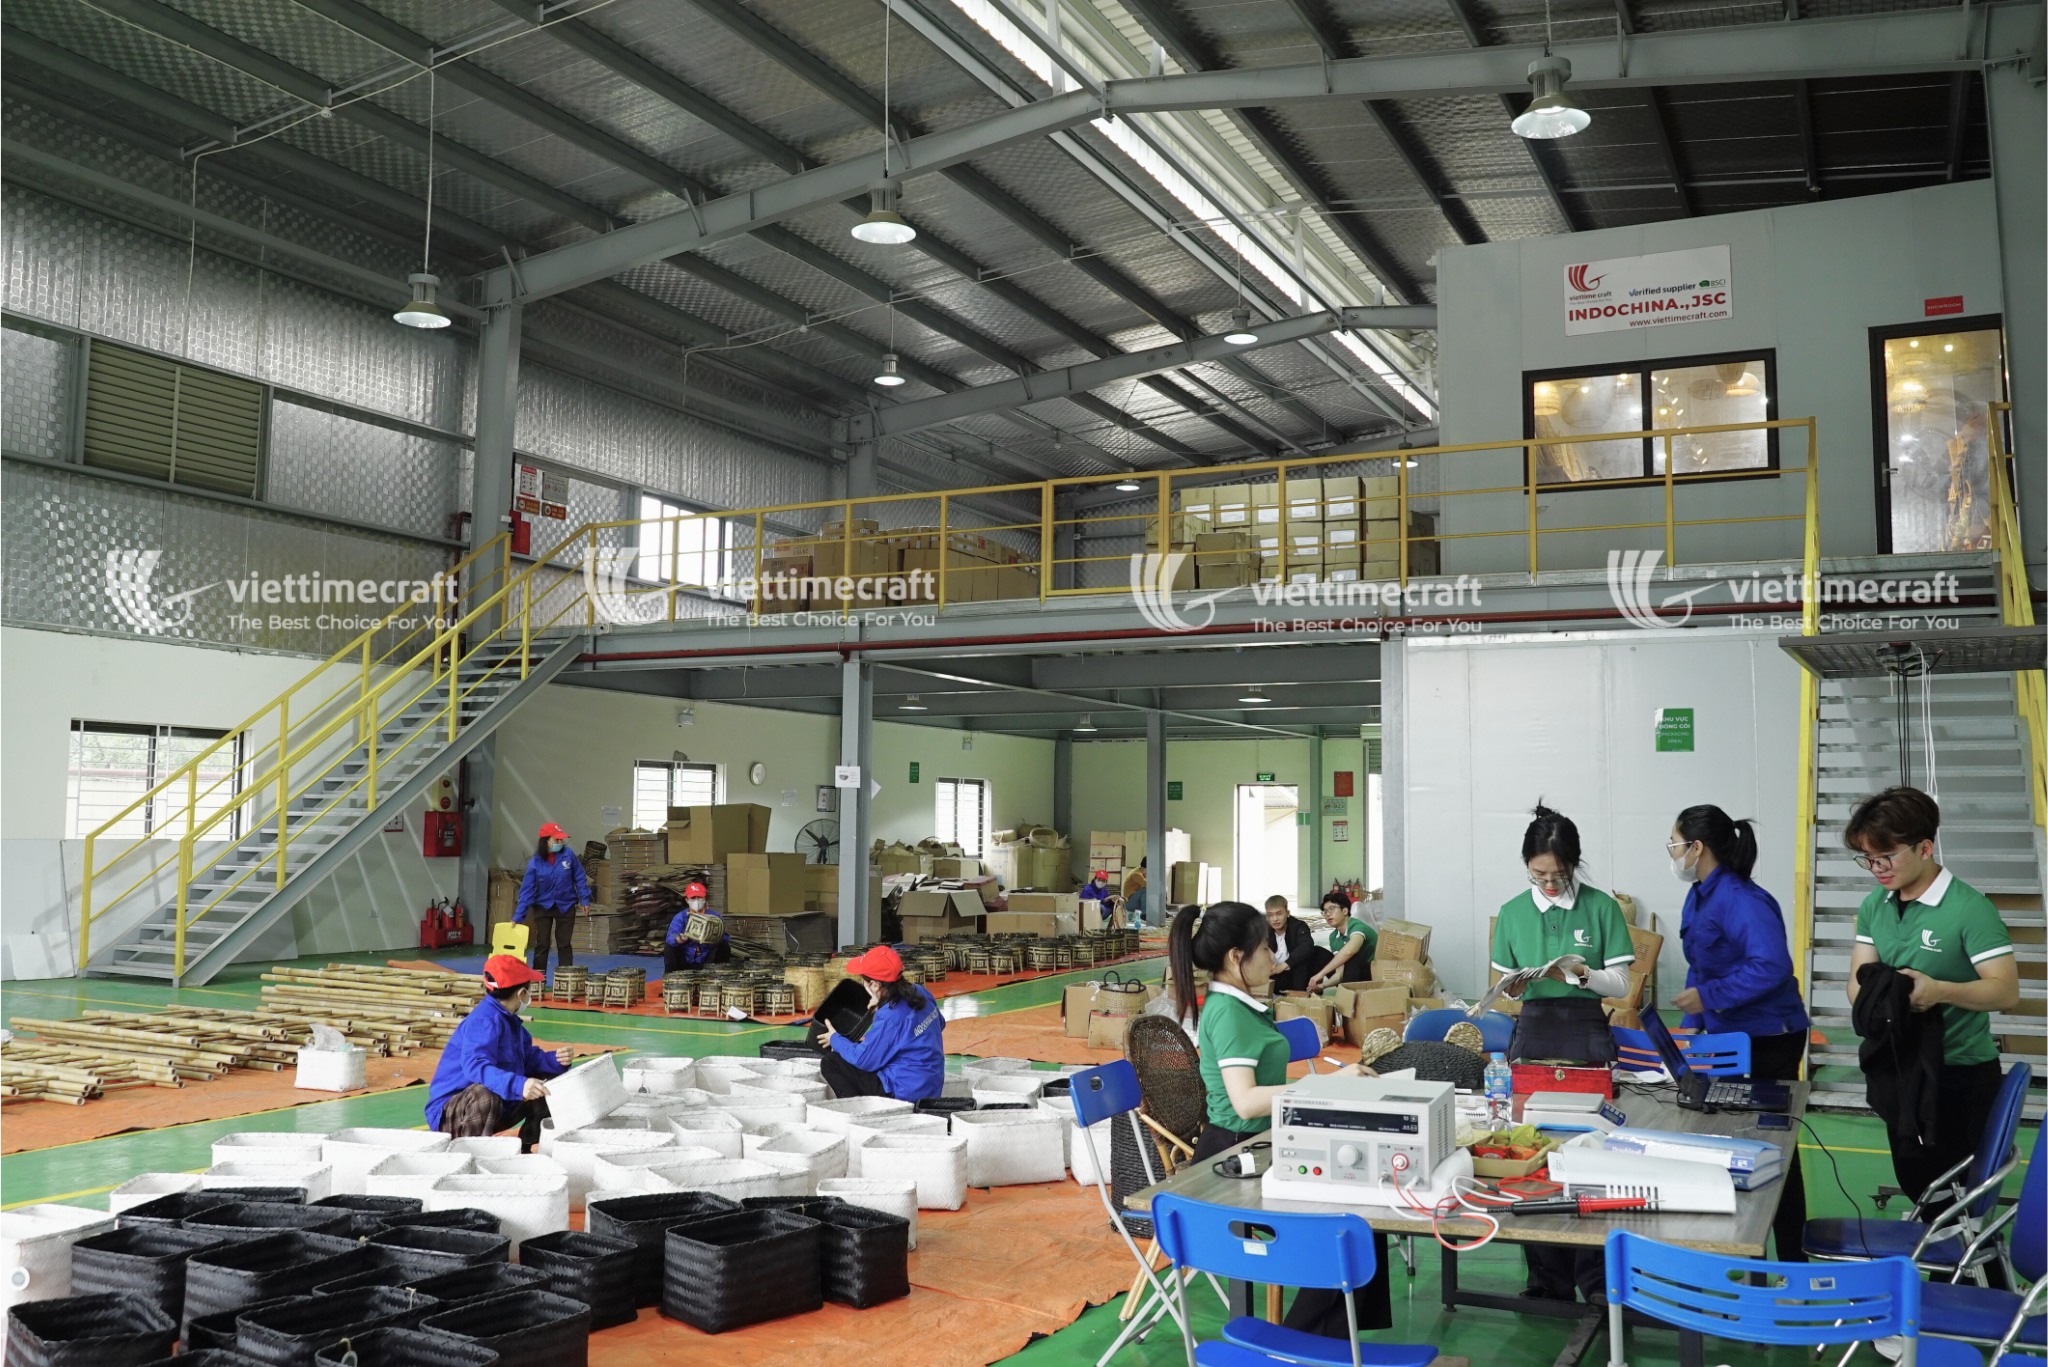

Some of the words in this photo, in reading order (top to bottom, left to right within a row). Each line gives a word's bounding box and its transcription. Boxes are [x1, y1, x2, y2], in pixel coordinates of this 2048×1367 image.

[1629, 286, 1661, 297] Verified
[1663, 283, 1696, 294] supplier
[1629, 309, 1728, 328] www.viettimecraft.com
